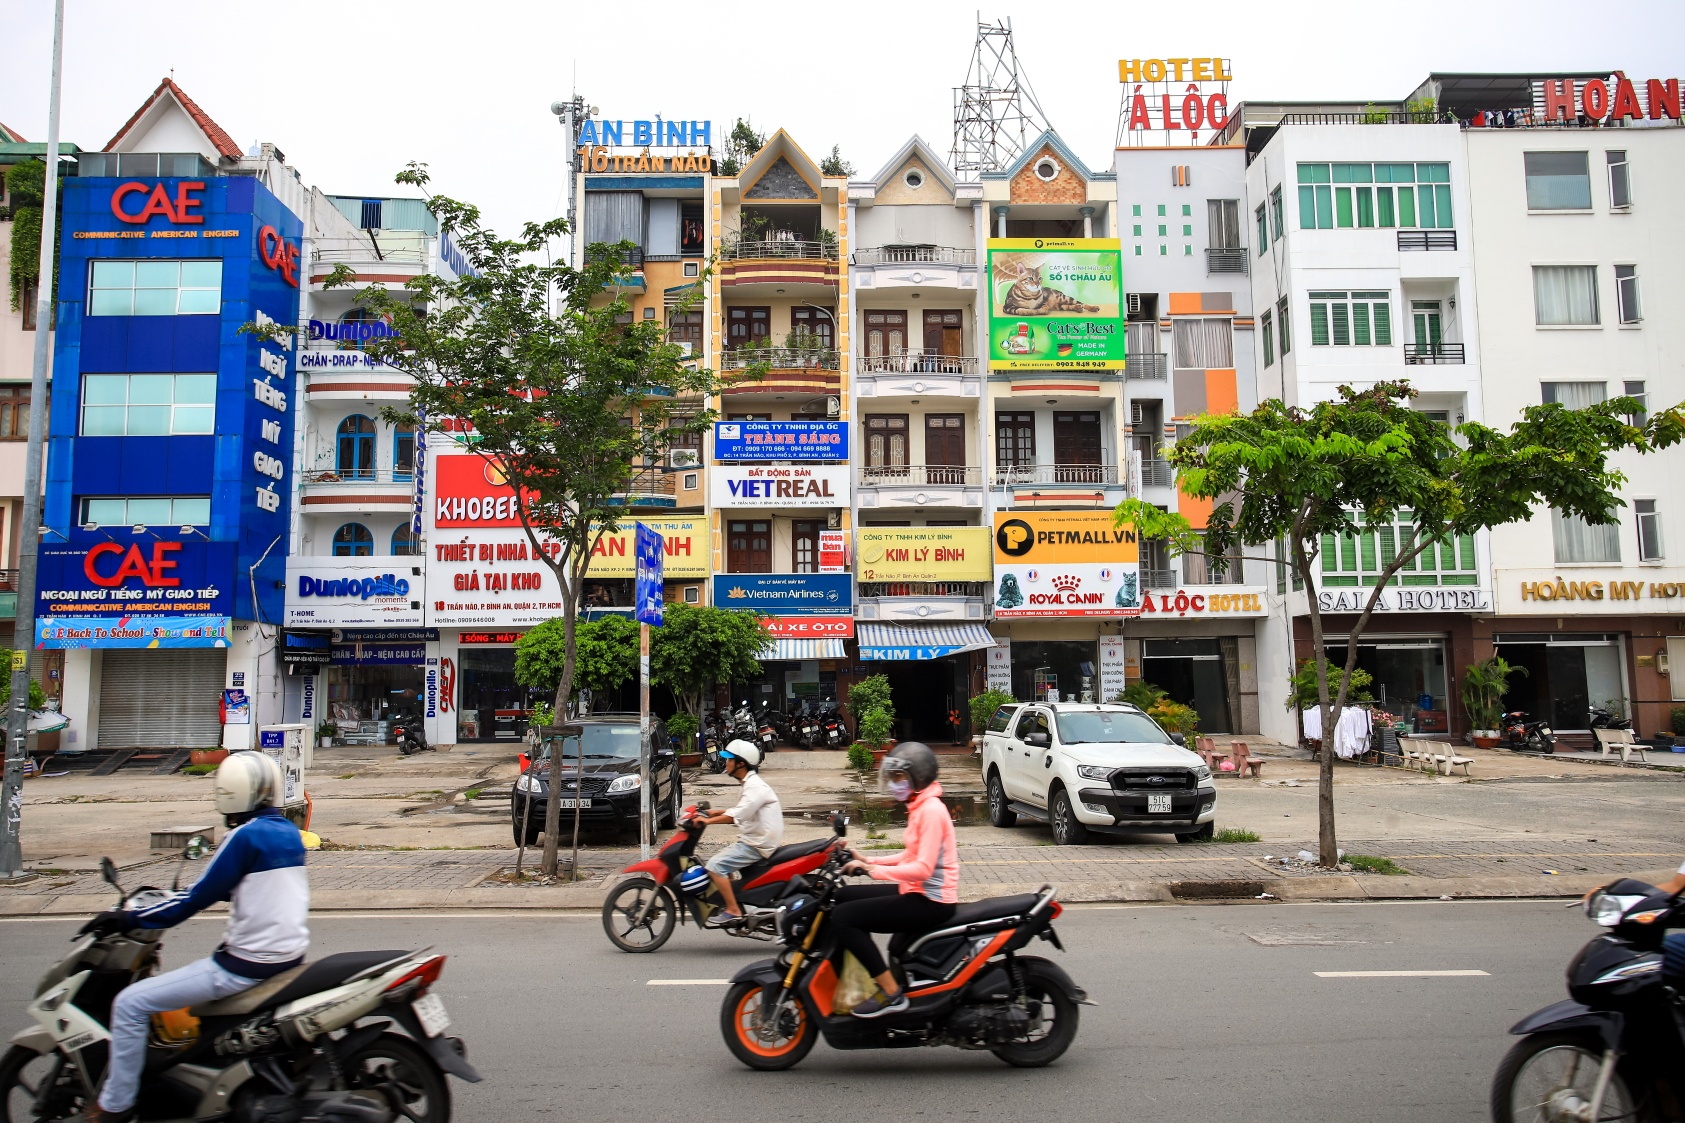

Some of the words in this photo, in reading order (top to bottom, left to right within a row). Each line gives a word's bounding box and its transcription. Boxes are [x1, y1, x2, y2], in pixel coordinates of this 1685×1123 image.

[1118, 58, 1232, 83] HOTEL
[1544, 70, 1685, 120] HOÀN
[1129, 84, 1151, 130] Á
[1162, 83, 1229, 139] LỘC
[577, 120, 623, 146] AN
[633, 111, 711, 146] BÌNH
[577, 146, 608, 173] 16
[612, 148, 664, 172] TRẦN
[671, 150, 711, 172] NÃO
[111, 182, 205, 223] CAE
[73, 231, 145, 239] COMMUNICATIVE
[258, 225, 299, 288] CAE
[1049, 271, 1062, 281] SỐ
[1070, 272, 1096, 281] CHÂU
[1047, 322, 1079, 335] Cat's
[1086, 322, 1116, 335] Best
[253, 375, 287, 412] TIẾNG
[826, 422, 838, 430] ỐC
[744, 431, 796, 445] THÀNH
[798, 431, 840, 444] SÁNG
[254, 451, 284, 480] GIAO
[748, 468, 764, 477] BẤT
[767, 469, 790, 479] ĐỘNG
[794, 468, 812, 477] SẢN
[256, 482, 280, 513] TIẾP
[727, 479, 835, 498] VIETREAL
[1038, 530, 1136, 544] PETMALL.VN
[435, 536, 476, 561] THIẾT
[479, 543, 494, 565] BỊ
[497, 538, 528, 560] NHÀ
[590, 537, 626, 556] AN
[886, 548, 909, 562] KIM
[914, 546, 930, 562] LÝ
[934, 546, 965, 562] BÌNH
[84, 542, 182, 587] CAE
[454, 570, 480, 590] GIÁ
[484, 573, 508, 594] TẠI
[511, 572, 542, 590] KHO
[864, 570, 874, 580] 12
[41, 590, 78, 602] NGOẠI
[81, 589, 107, 600] NGỮ
[110, 586, 143, 600] TIẾNG
[147, 588, 164, 600] MỸ
[166, 589, 194, 599] GIAO
[197, 584, 220, 599] TIẾP
[299, 574, 410, 600] Dunlopillo
[746, 589, 788, 599] Vietnam
[788, 589, 824, 598] Airlines
[1521, 576, 1604, 601] HOÀNG
[1609, 581, 1645, 601] MY
[50, 604, 124, 612] COMMUNICATIVE
[125, 603, 171, 612] AMERICAN
[174, 602, 210, 611] ENGLISH
[1030, 593, 1064, 605] ROYAL
[1066, 592, 1103, 604] CANIN
[1141, 590, 1156, 613] Á
[1160, 590, 1205, 616] LỘC
[1208, 594, 1262, 612] HOTEL
[1319, 592, 1391, 612] SALA
[1398, 590, 1488, 610] HOTEL
[42, 628, 64, 639] CAE
[66, 628, 92, 639] Back
[94, 628, 108, 639] To
[110, 627, 144, 638] School
[152, 627, 180, 638] Show
[182, 627, 202, 638] and
[205, 626, 226, 638] Tell
[812, 622, 848, 631] ÔTÔ
[375, 631, 386, 641] cấp
[387, 632, 399, 640] đến
[408, 631, 425, 640] Châu
[465, 632, 488, 642] SÓNG
[496, 632, 514, 642] MÁY
[395, 650, 410, 658] CAO
[412, 647, 426, 659] CẤP
[873, 648, 910, 660] KIM
[916, 646, 940, 660] LÝ
[303, 675, 314, 718] Dunlopill
[426, 670, 438, 718] Dunlopillo
[1148, 804, 1171, 812] 777.59
[1153, 796, 1166, 804] 51C
